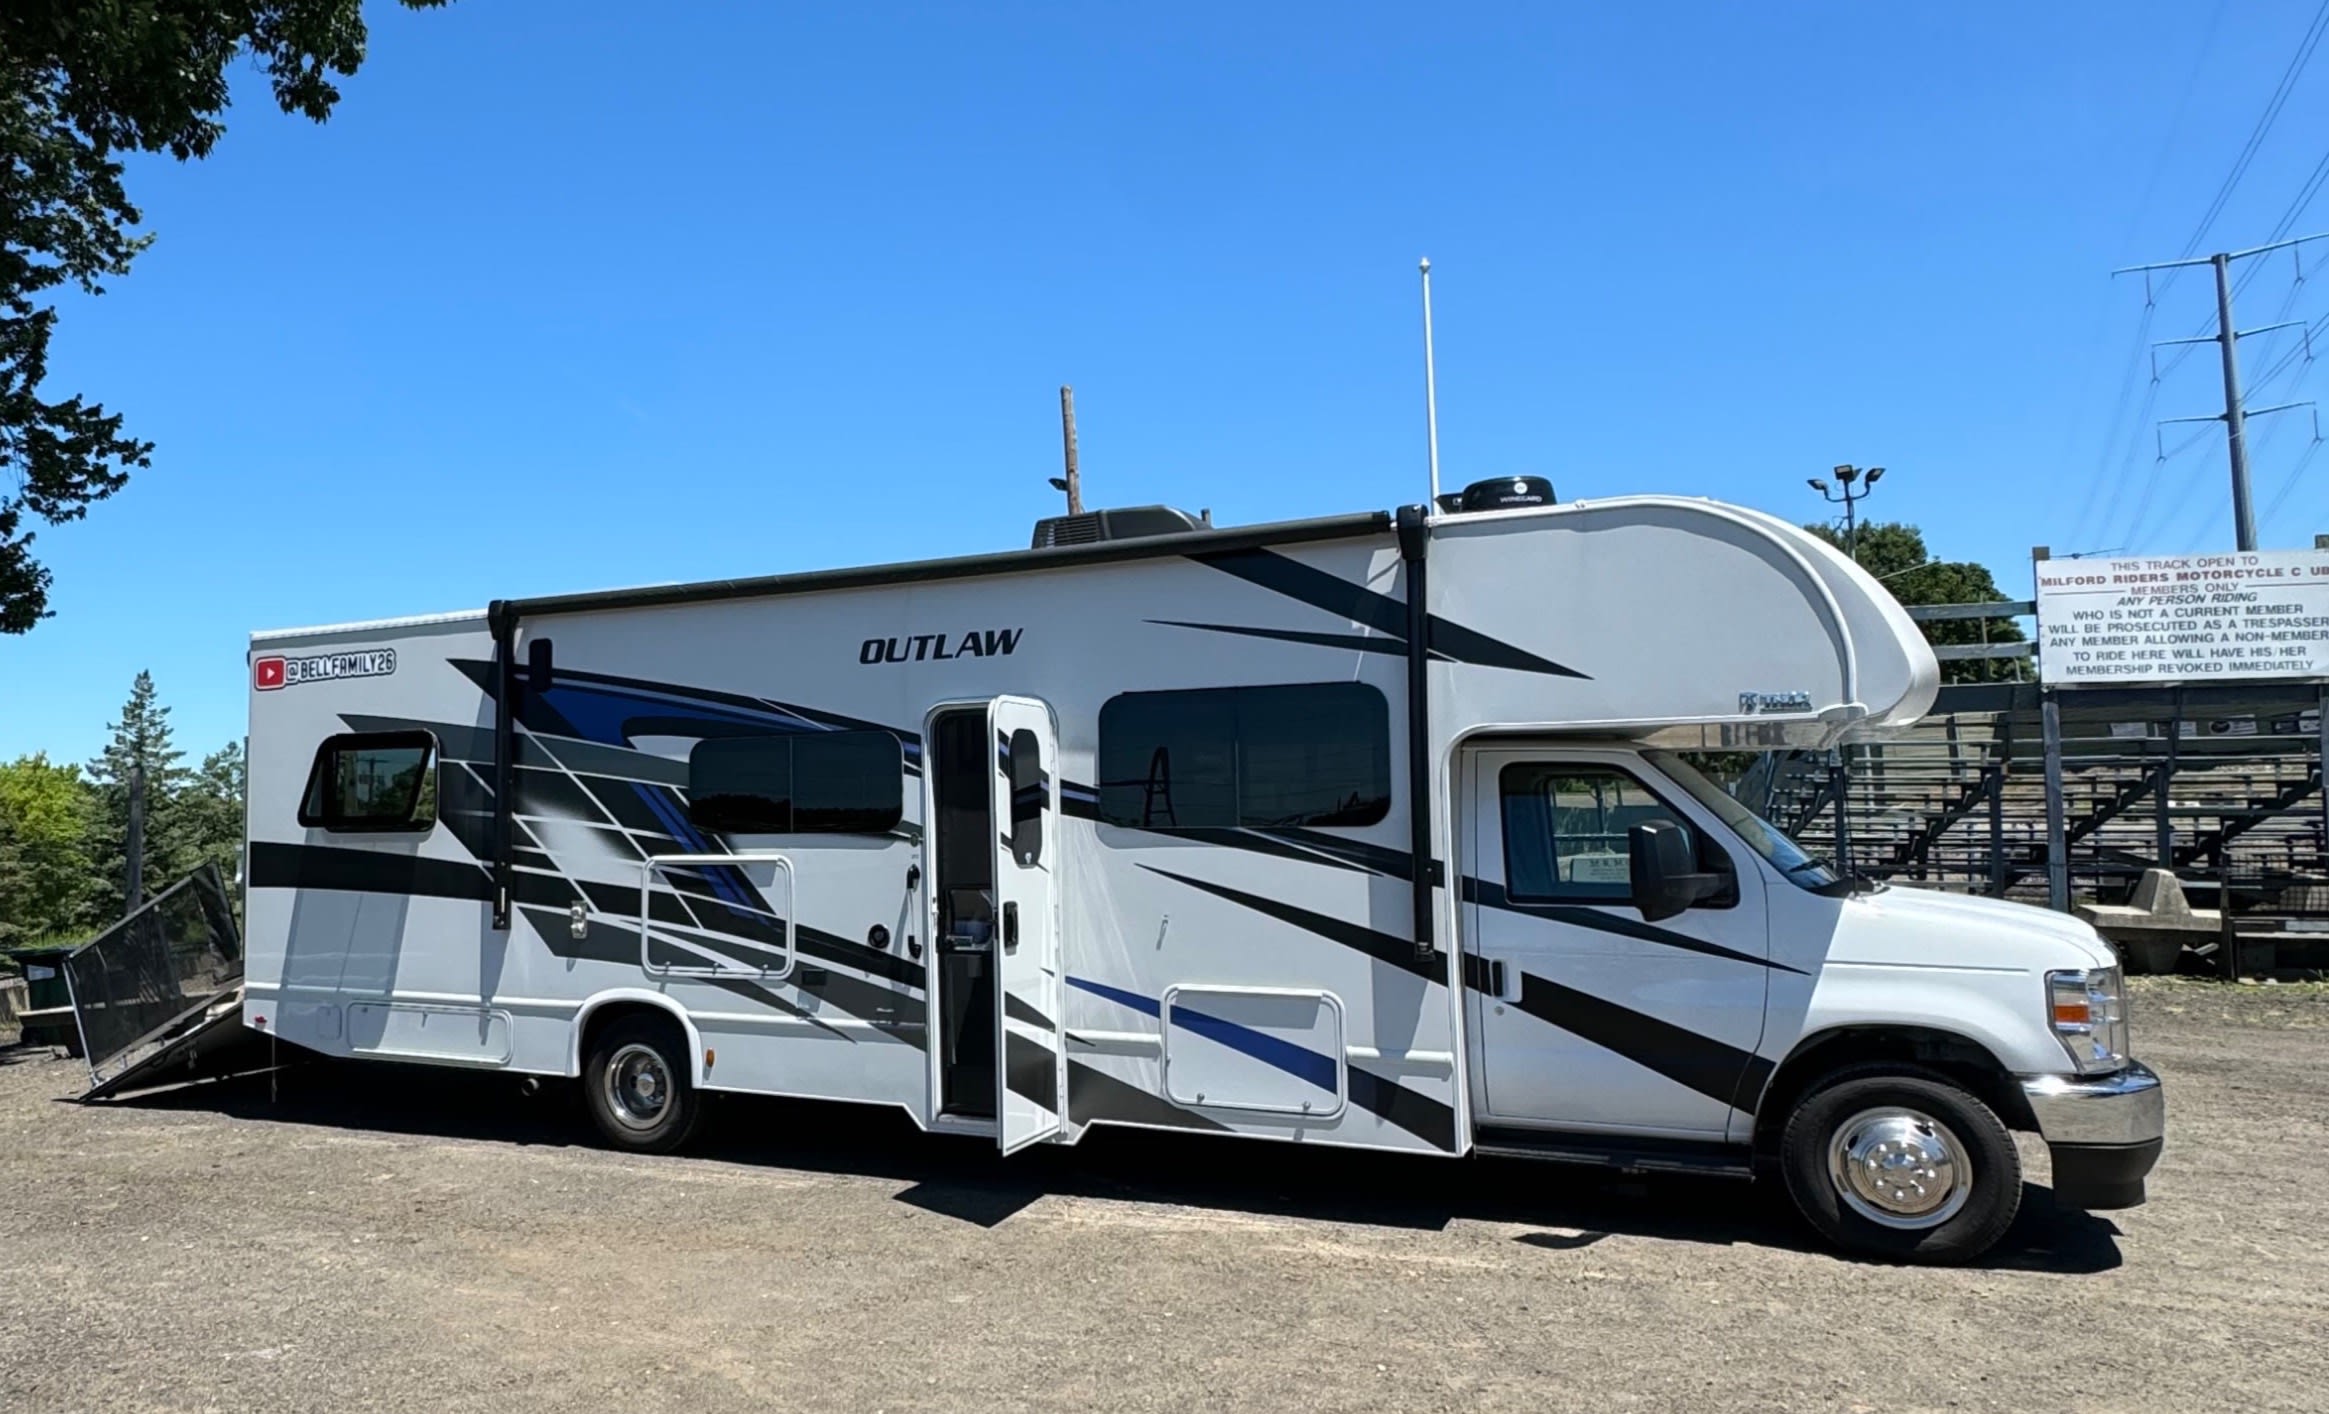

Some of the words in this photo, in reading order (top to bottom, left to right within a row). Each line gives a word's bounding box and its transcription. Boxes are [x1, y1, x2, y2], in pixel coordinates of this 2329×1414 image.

[2110, 561, 2140, 571] THIS
[2146, 559, 2191, 570] TRACK
[2197, 557, 2235, 568] OPEN
[2240, 556, 2259, 566] TO
[2041, 576, 2106, 586] MILFORD
[2113, 573, 2169, 584] RIDERS
[2176, 568, 2284, 581] MOTORCYCLE
[2131, 584, 2199, 595] MEMBERS
[2204, 582, 2239, 592] ONLY
[2117, 596, 2144, 606] ANY
[2149, 594, 2206, 605] PERSON
[2211, 592, 2258, 603] RIDING
[2073, 610, 2104, 620] WHO
[2110, 610, 2122, 619] IS
[2128, 609, 2153, 619] NOT
[2160, 609, 2168, 618] A
[2174, 606, 2239, 617] CURRENT
[2246, 604, 2303, 615] MEMBER
[2048, 625, 2078, 634] WILL
[2084, 624, 2100, 633] BE
[2108, 621, 2197, 632] PROSECUTED
[2203, 620, 2221, 630] AS
[2228, 620, 2237, 629] A
[2243, 617, 2329, 628] TRESPASSER
[859, 627, 1023, 664] OUTLAW
[2050, 637, 2075, 647] ANY
[2082, 635, 2138, 646] MEMBER
[2144, 633, 2214, 644] ALLOWING
[2220, 633, 2231, 642] A
[2235, 630, 2329, 642] NON-MEMBER
[2073, 652, 2090, 661] TO
[2096, 651, 2126, 660] RIDE
[2132, 650, 2166, 659] HERE
[2172, 649, 2205, 659] WILL
[2210, 648, 2245, 658] HAVE
[287, 652, 394, 679] @BELLFAMILY26
[2066, 664, 2152, 675] MEMBERSHIP
[2158, 662, 2223, 673] REVOKED
[2229, 660, 2313, 672] IMMEDIATELY
